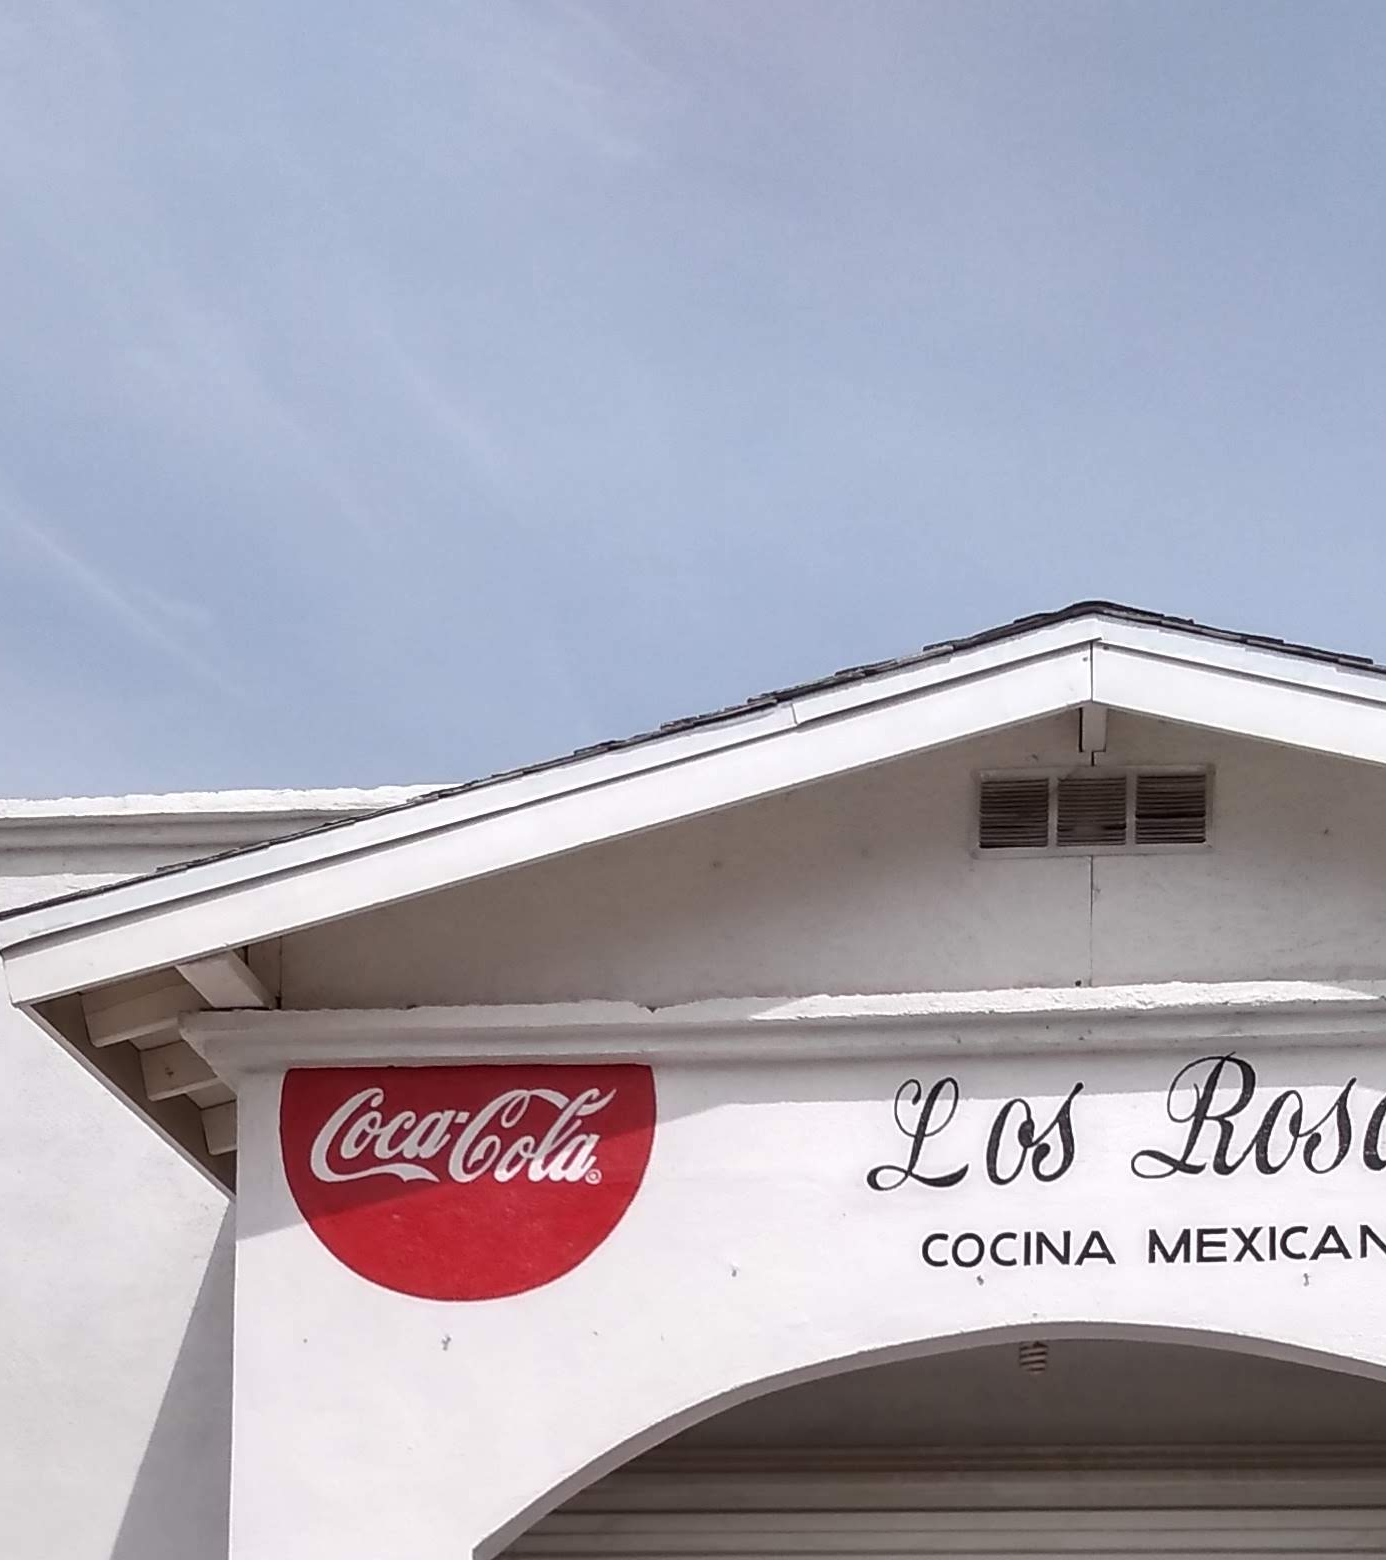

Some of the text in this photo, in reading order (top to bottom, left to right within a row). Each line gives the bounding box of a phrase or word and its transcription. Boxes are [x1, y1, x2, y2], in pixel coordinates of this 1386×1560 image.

[310, 1086, 617, 1184] Coca-Cola
[867, 1076, 1084, 1191] Los
[921, 1229, 1116, 1268] COCINA
